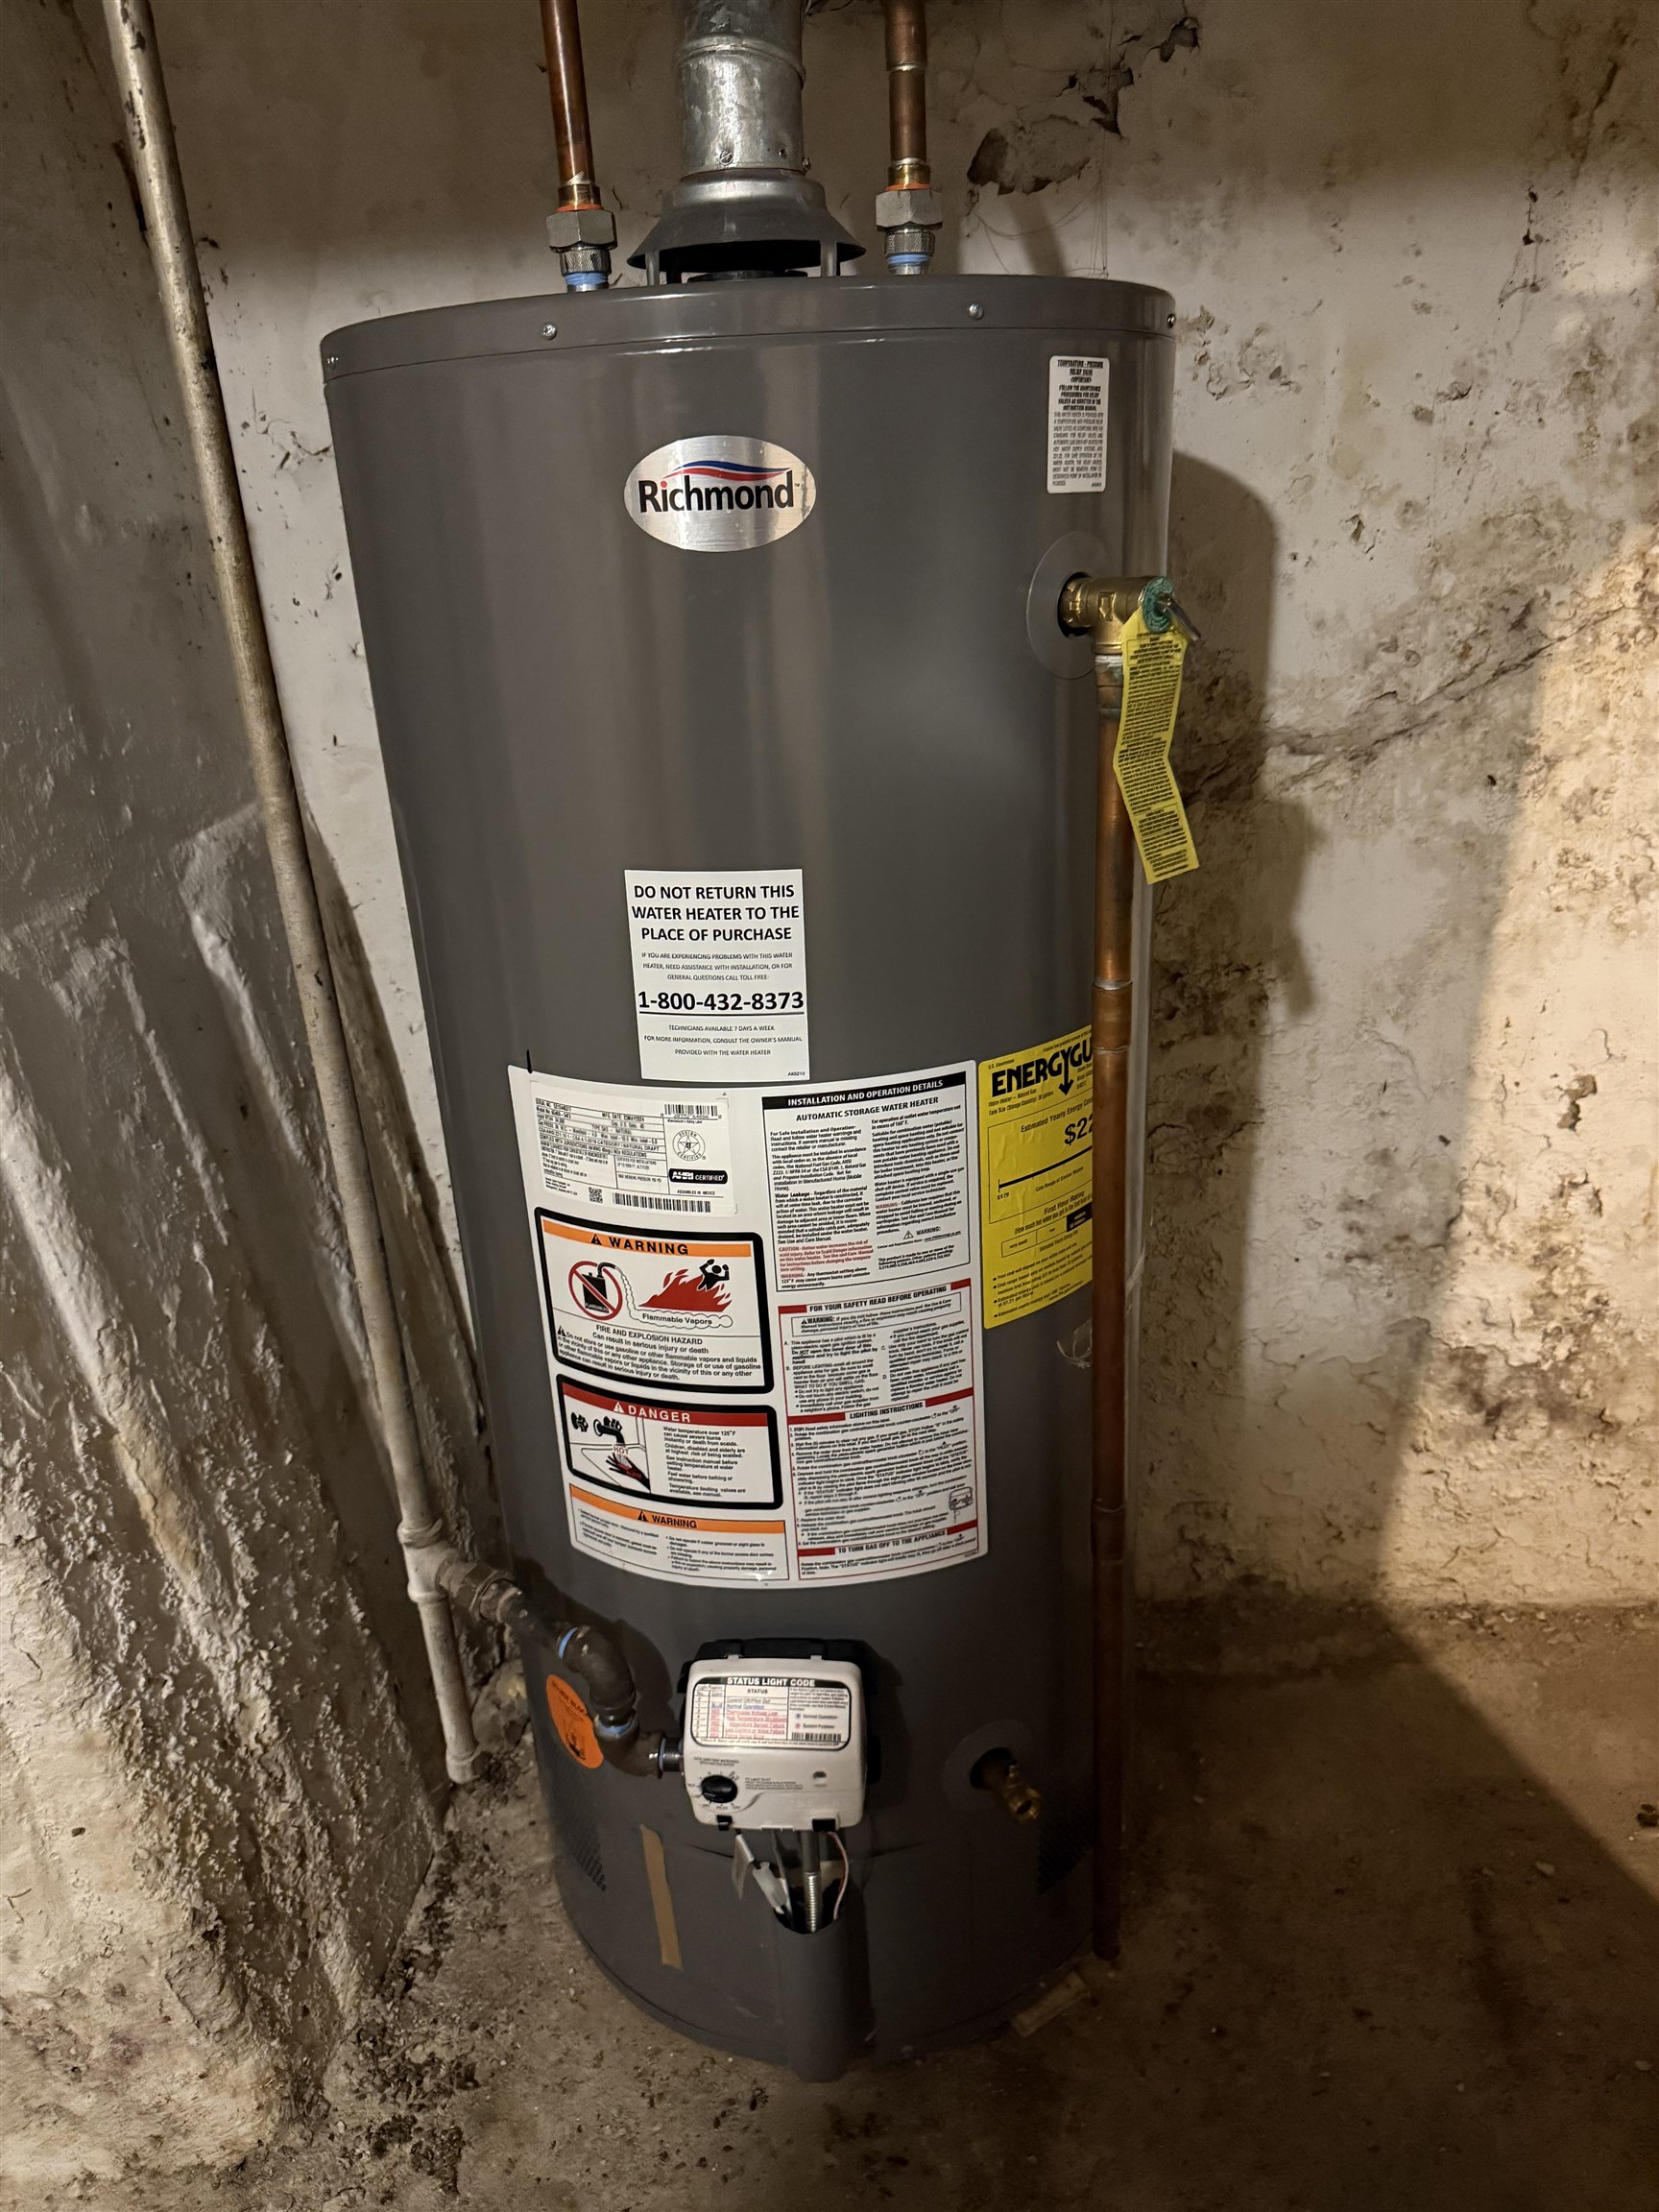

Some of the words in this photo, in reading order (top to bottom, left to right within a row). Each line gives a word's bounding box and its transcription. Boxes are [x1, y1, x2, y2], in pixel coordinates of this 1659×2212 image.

[638, 470, 794, 513] Richmond
[634, 886, 655, 899] DO
[660, 886, 691, 899] NOT
[696, 886, 756, 899] RETURN
[760, 885, 794, 898] THIS
[632, 907, 681, 920] WATER
[686, 907, 741, 921] HEATER
[745, 907, 766, 920] TO
[770, 906, 799, 920] THE
[642, 928, 685, 942] PLACE
[689, 929, 708, 942] OF
[713, 927, 792, 942] PURCHASE
[643, 963, 664, 971] HEATER,
[731, 963, 770, 971] INSTALLATION,
[638, 991, 804, 1010] 1-800-432-8373
[673, 1036, 712, 1045] INFORMATION,
[788, 1095, 845, 1105] INSTALLATION
[847, 1092, 864, 1101] AND
[866, 1086, 910, 1098] OPERATION
[912, 1080, 943, 1091] DETAILS
[796, 1111, 843, 1121] AUTOMATIC
[845, 1106, 880, 1117] STORAGE
[881, 1102, 908, 1112] WATER
[910, 1097, 938, 1107] HEATER
[609, 1236, 688, 1255] WARNING
[825, 1303, 842, 1311] YOUR
[844, 1300, 867, 1309] SAFETY
[870, 1297, 886, 1305] READ
[888, 1293, 912, 1302] BEFORE
[913, 1286, 946, 1298] OPERATING
[643, 1313, 683, 1323] Flammable
[685, 1317, 712, 1327] Vapors
[596, 1325, 611, 1333] FIRE
[613, 1328, 627, 1336] AND
[629, 1331, 669, 1342] EXPLOSION
[672, 1336, 702, 1345] HAZARD
[606, 1336, 623, 1344] result
[633, 1341, 656, 1349] serious
[659, 1344, 678, 1353] injury
[665, 1353, 697, 1361] flammable
[671, 1360, 694, 1369] Storage
[670, 1367, 690, 1376] vicinity
[629, 1405, 690, 1423] DANGER
[850, 1410, 878, 1419] LIGHTING
[880, 1402, 923, 1415] INSTRUCTIONS
[652, 1513, 697, 1529] WARNING
[914, 1530, 945, 1542] APPLIANCE
